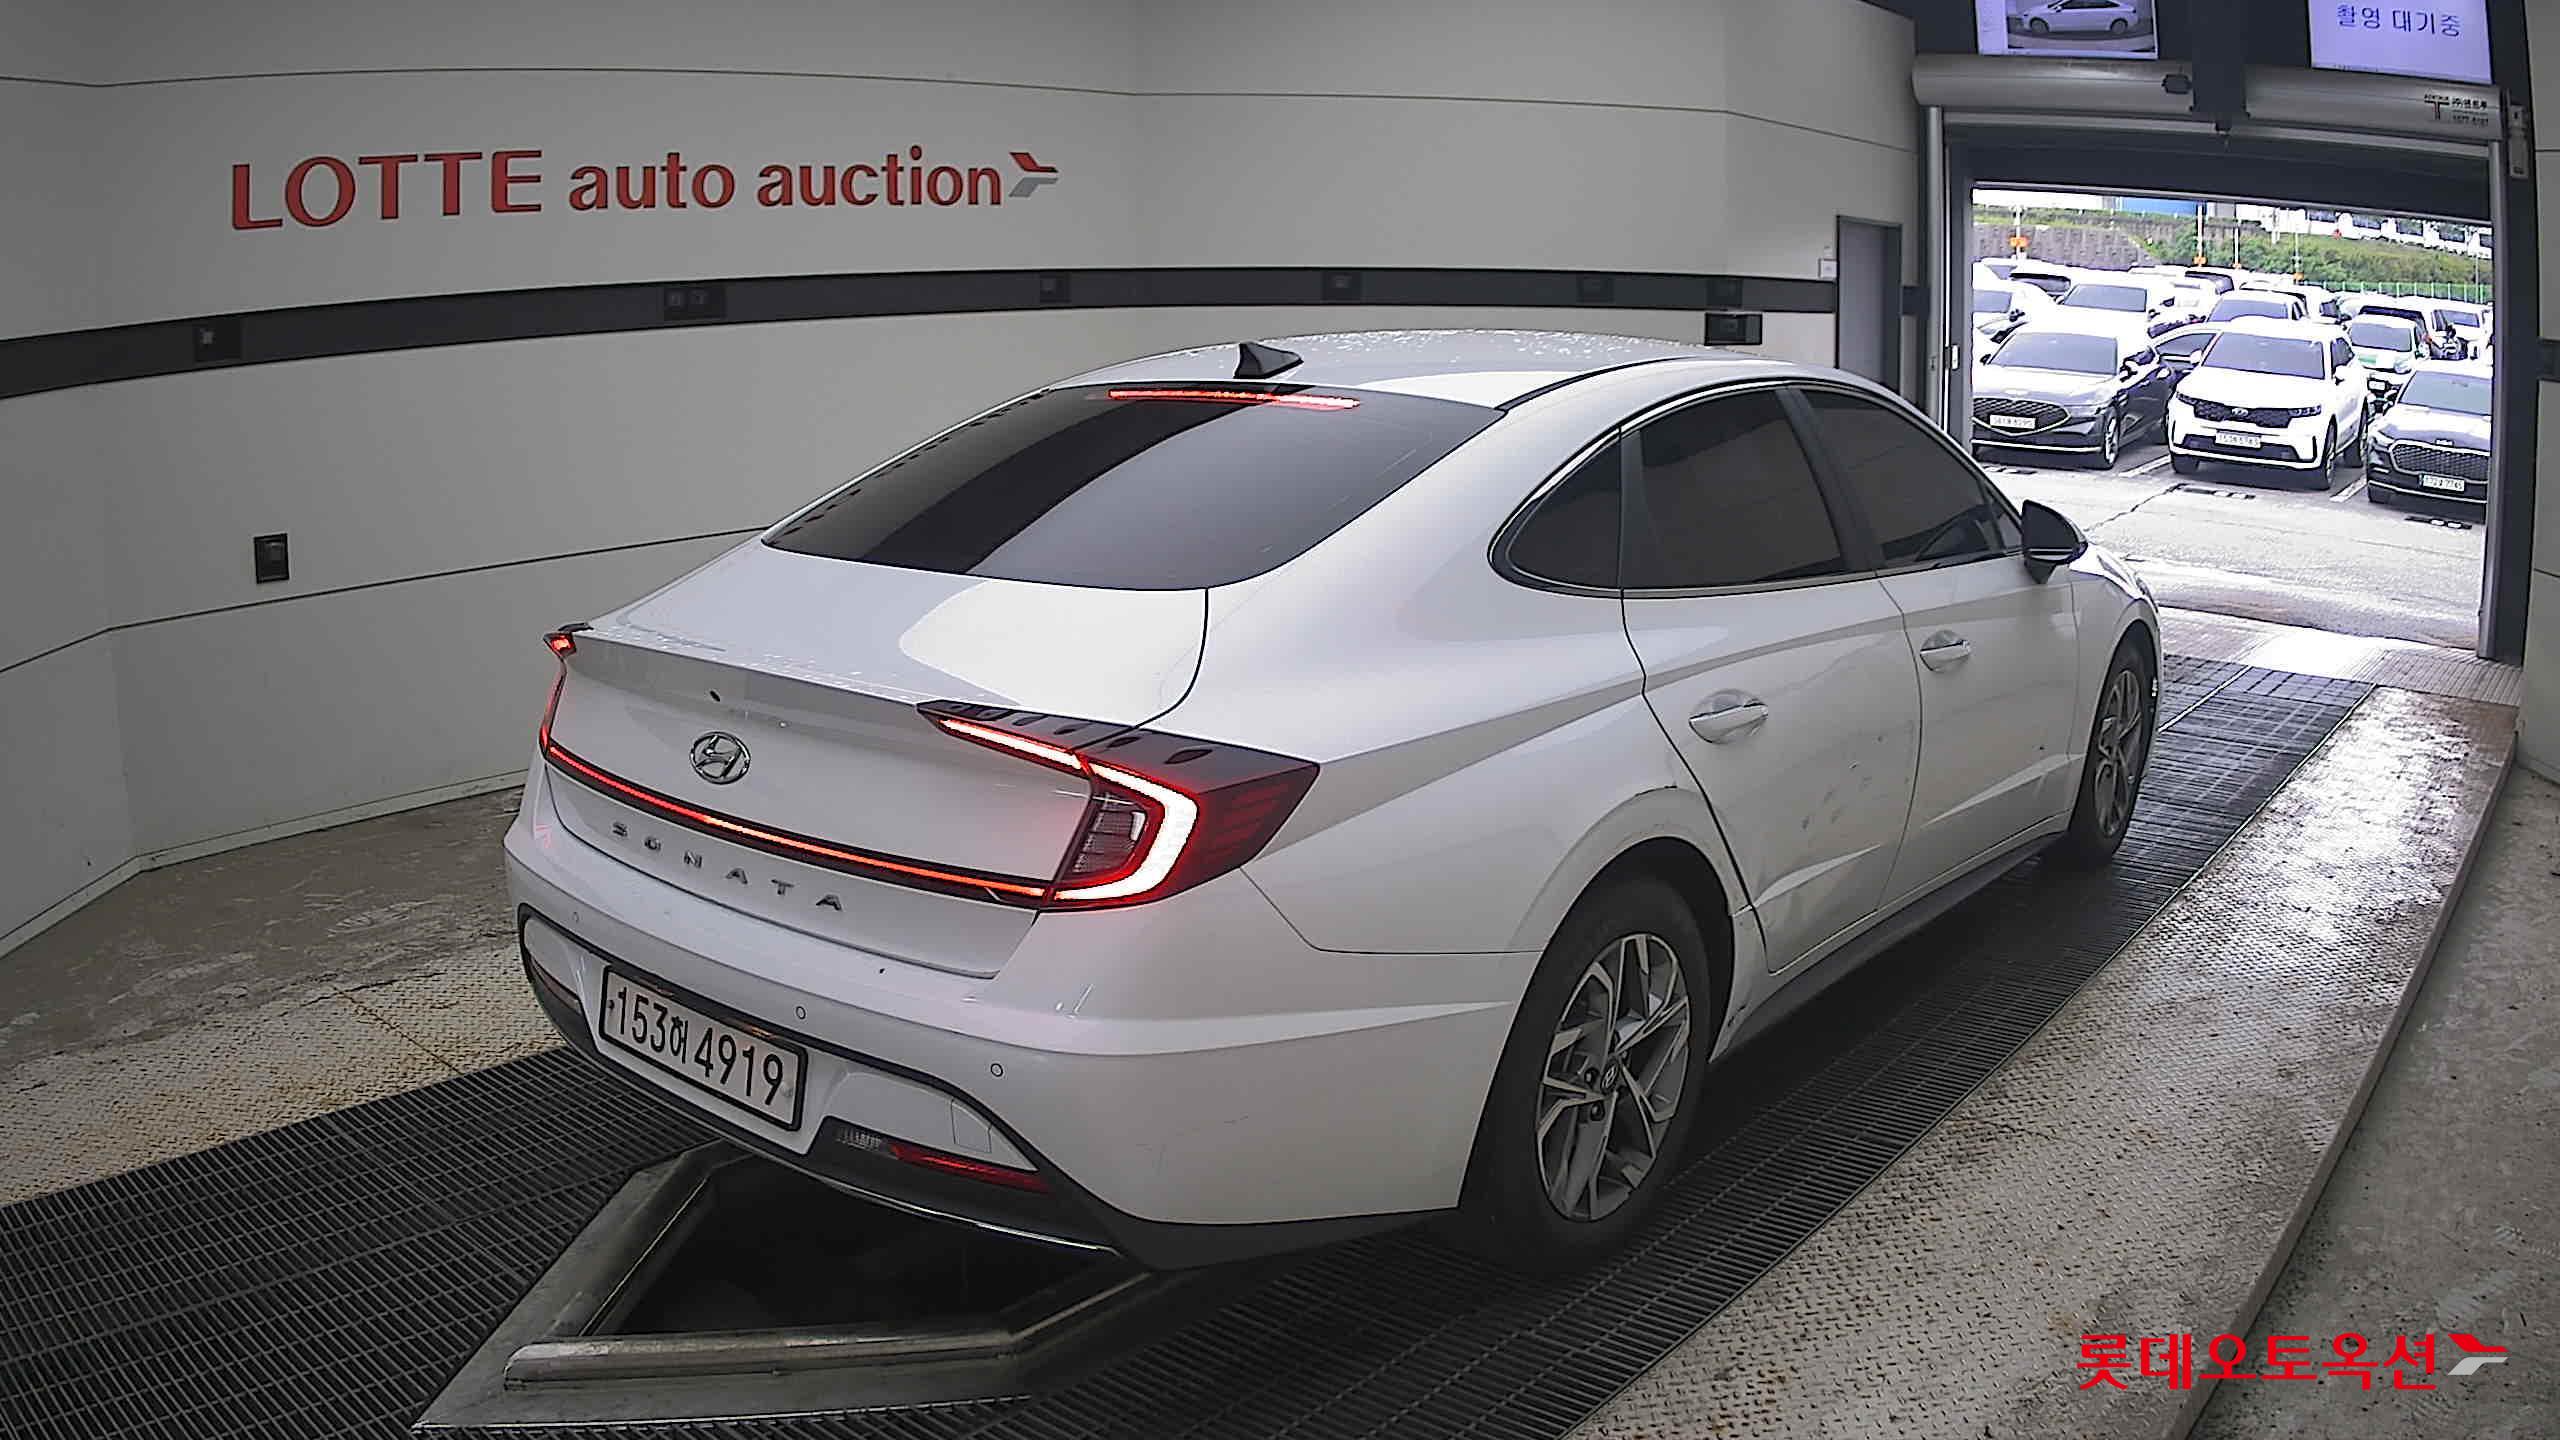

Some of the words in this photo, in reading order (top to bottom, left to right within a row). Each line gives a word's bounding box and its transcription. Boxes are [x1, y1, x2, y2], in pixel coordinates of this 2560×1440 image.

[2337, 4, 2381, 29] 촬영
[2392, 9, 2461, 37] 대기중
[232, 149, 542, 230] LOTTE
[568, 152, 736, 211] auto
[757, 145, 1002, 207] auction
[612, 821, 844, 912] SONATA
[617, 986, 784, 1106] 153허4919
